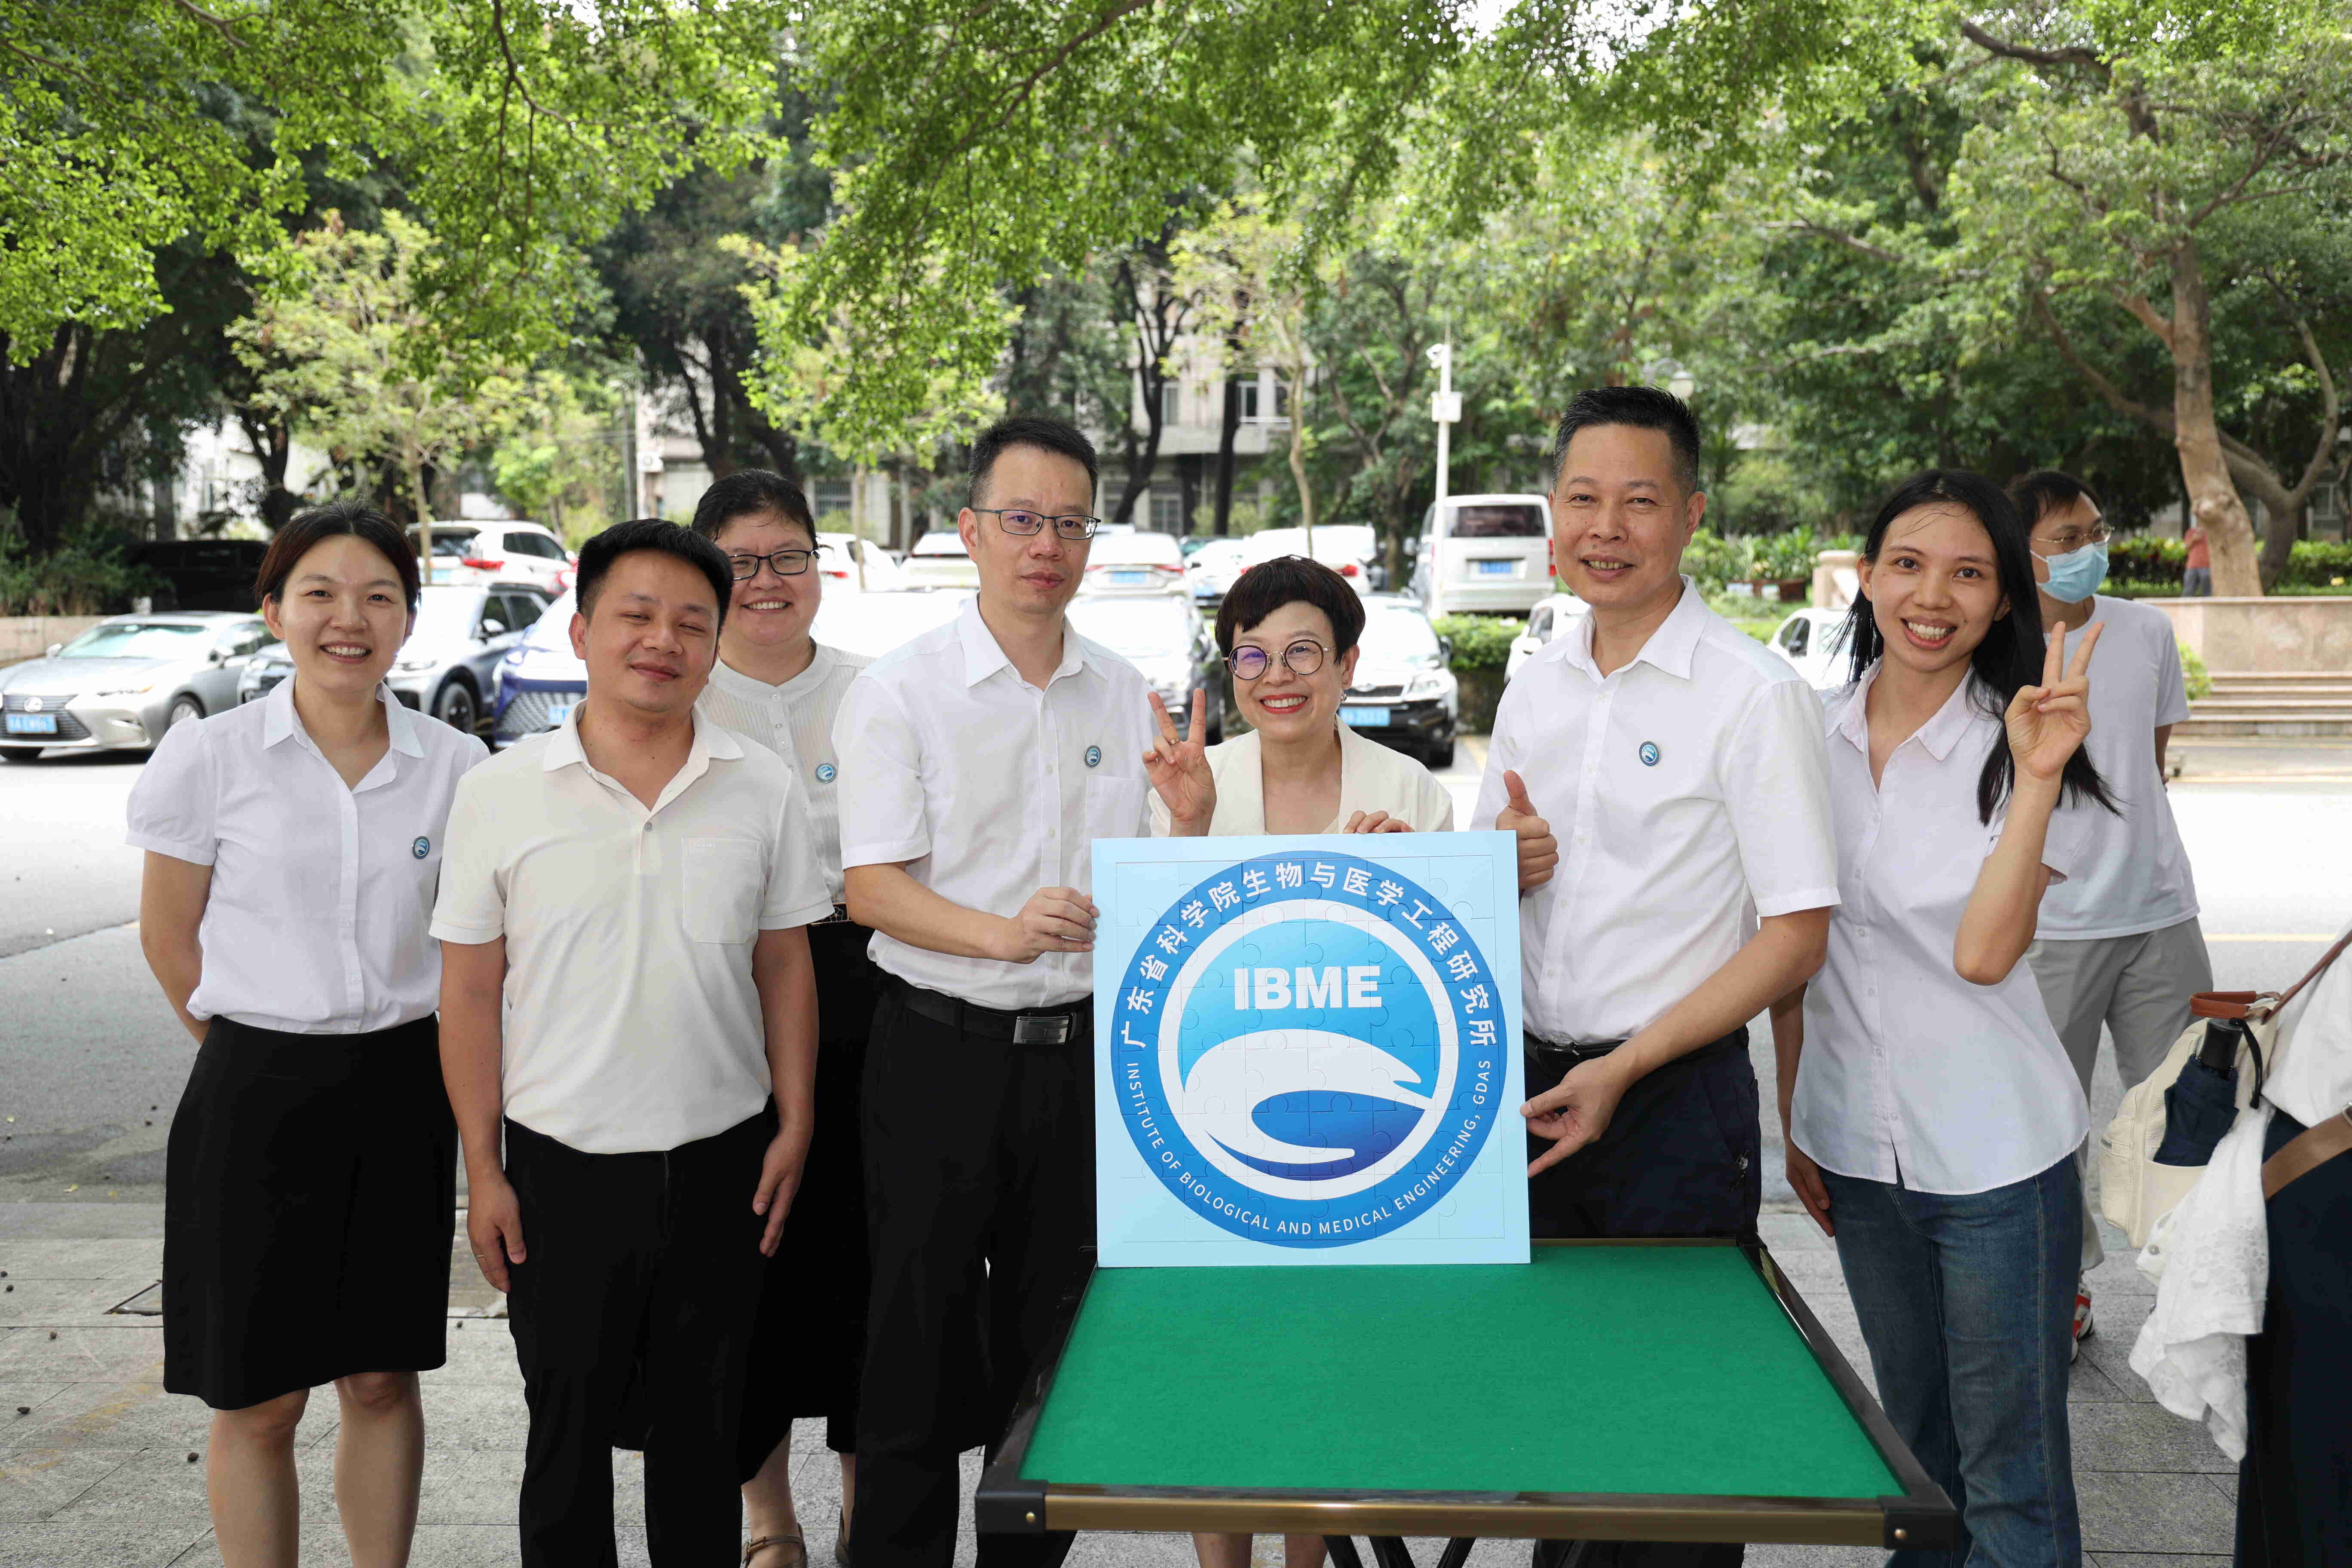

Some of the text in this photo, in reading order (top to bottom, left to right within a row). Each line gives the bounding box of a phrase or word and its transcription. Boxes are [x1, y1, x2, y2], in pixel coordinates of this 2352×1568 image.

[1121, 861, 1496, 1048] 广东省科学院生物与医学工程研究所
[1234, 966, 1382, 1010] IBME
[1127, 1060, 1491, 1235] INSTITUTE OF BIOLOGICAL AND MEDICAL ENGINEERING, GDAS
